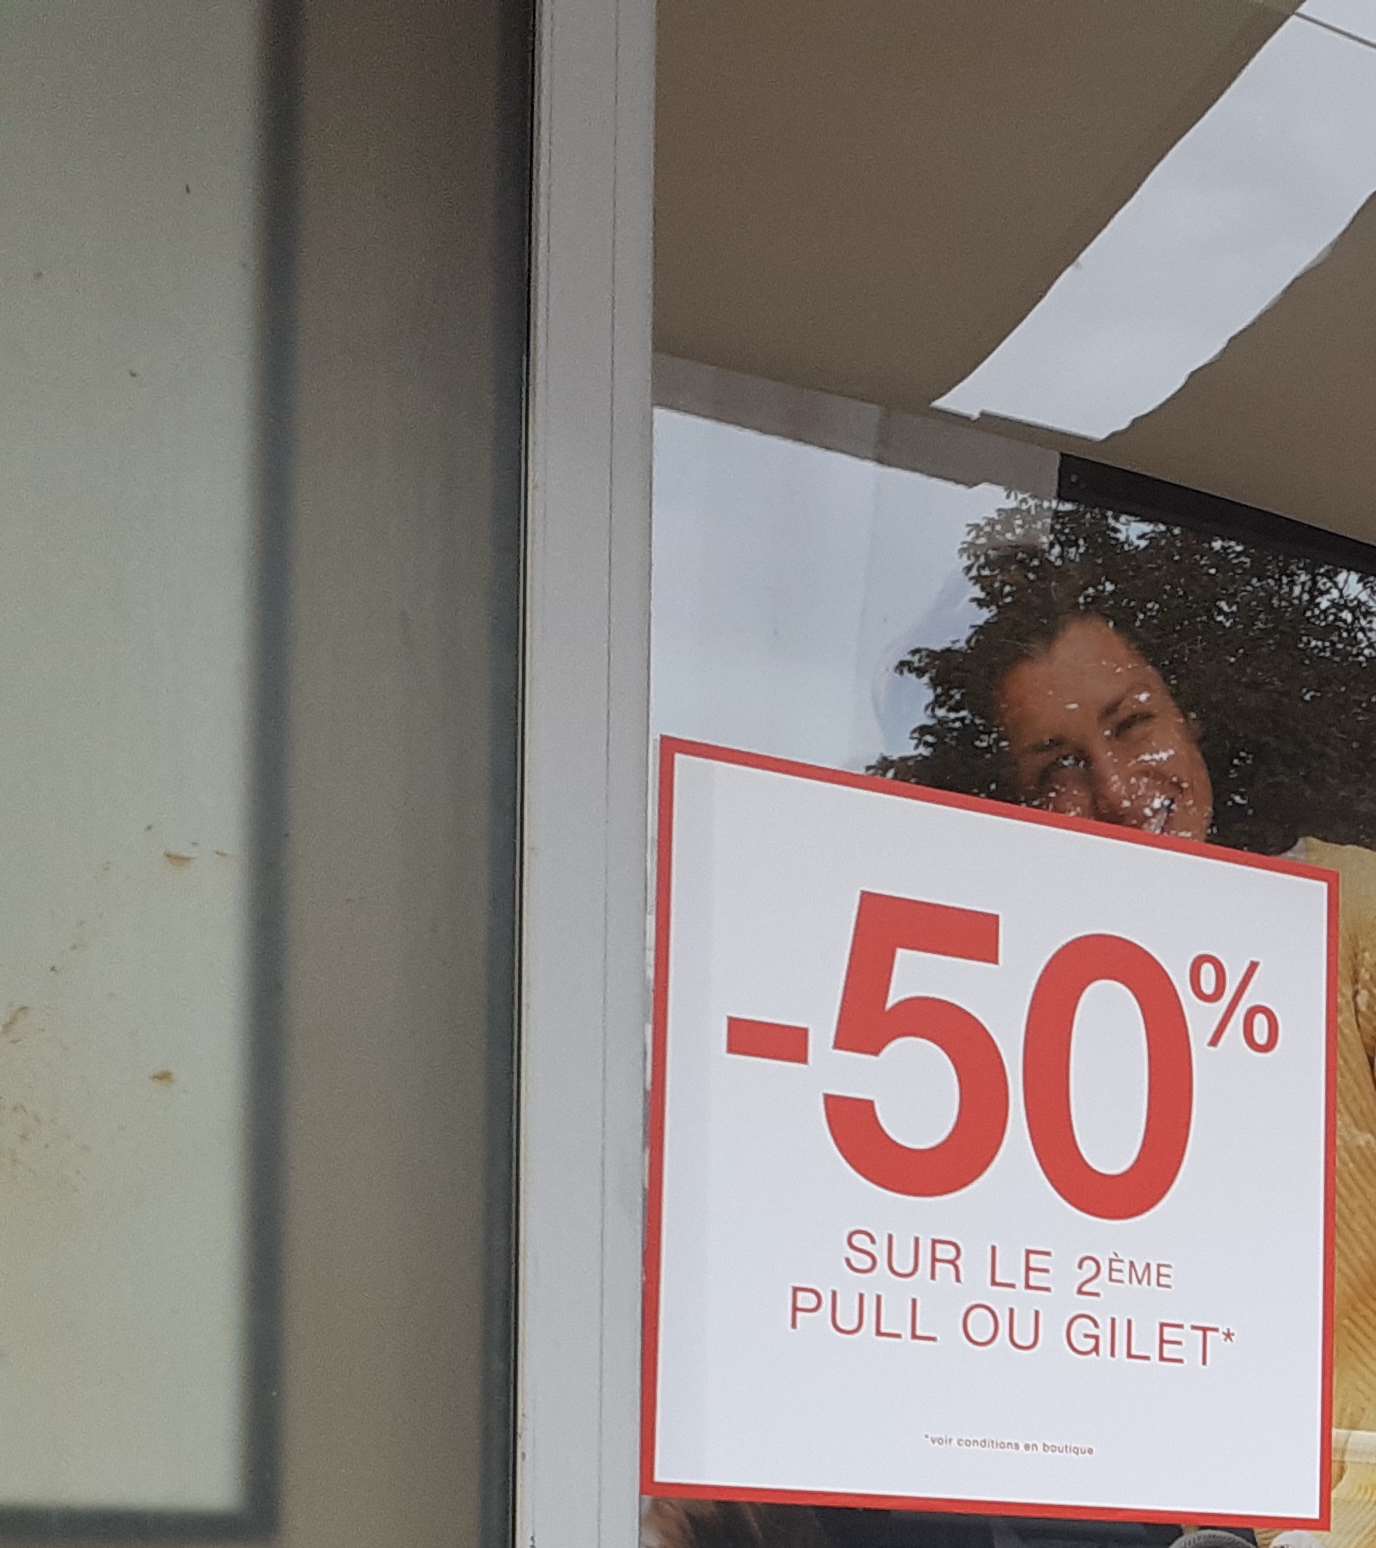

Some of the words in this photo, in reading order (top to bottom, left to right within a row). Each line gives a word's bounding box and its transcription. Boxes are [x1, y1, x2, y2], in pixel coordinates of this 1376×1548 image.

[726, 890, 1279, 1220] -50%
[844, 1228, 963, 1284] SUR
[989, 1245, 1052, 1293] LE
[1076, 1252, 1173, 1298] 2ÈME
[790, 1285, 938, 1342] PULL
[962, 1303, 1041, 1351] OU
[957, 1437, 1020, 1451] conditions
[1024, 1443, 1039, 1452] en
[1043, 1442, 1094, 1456] boutique
